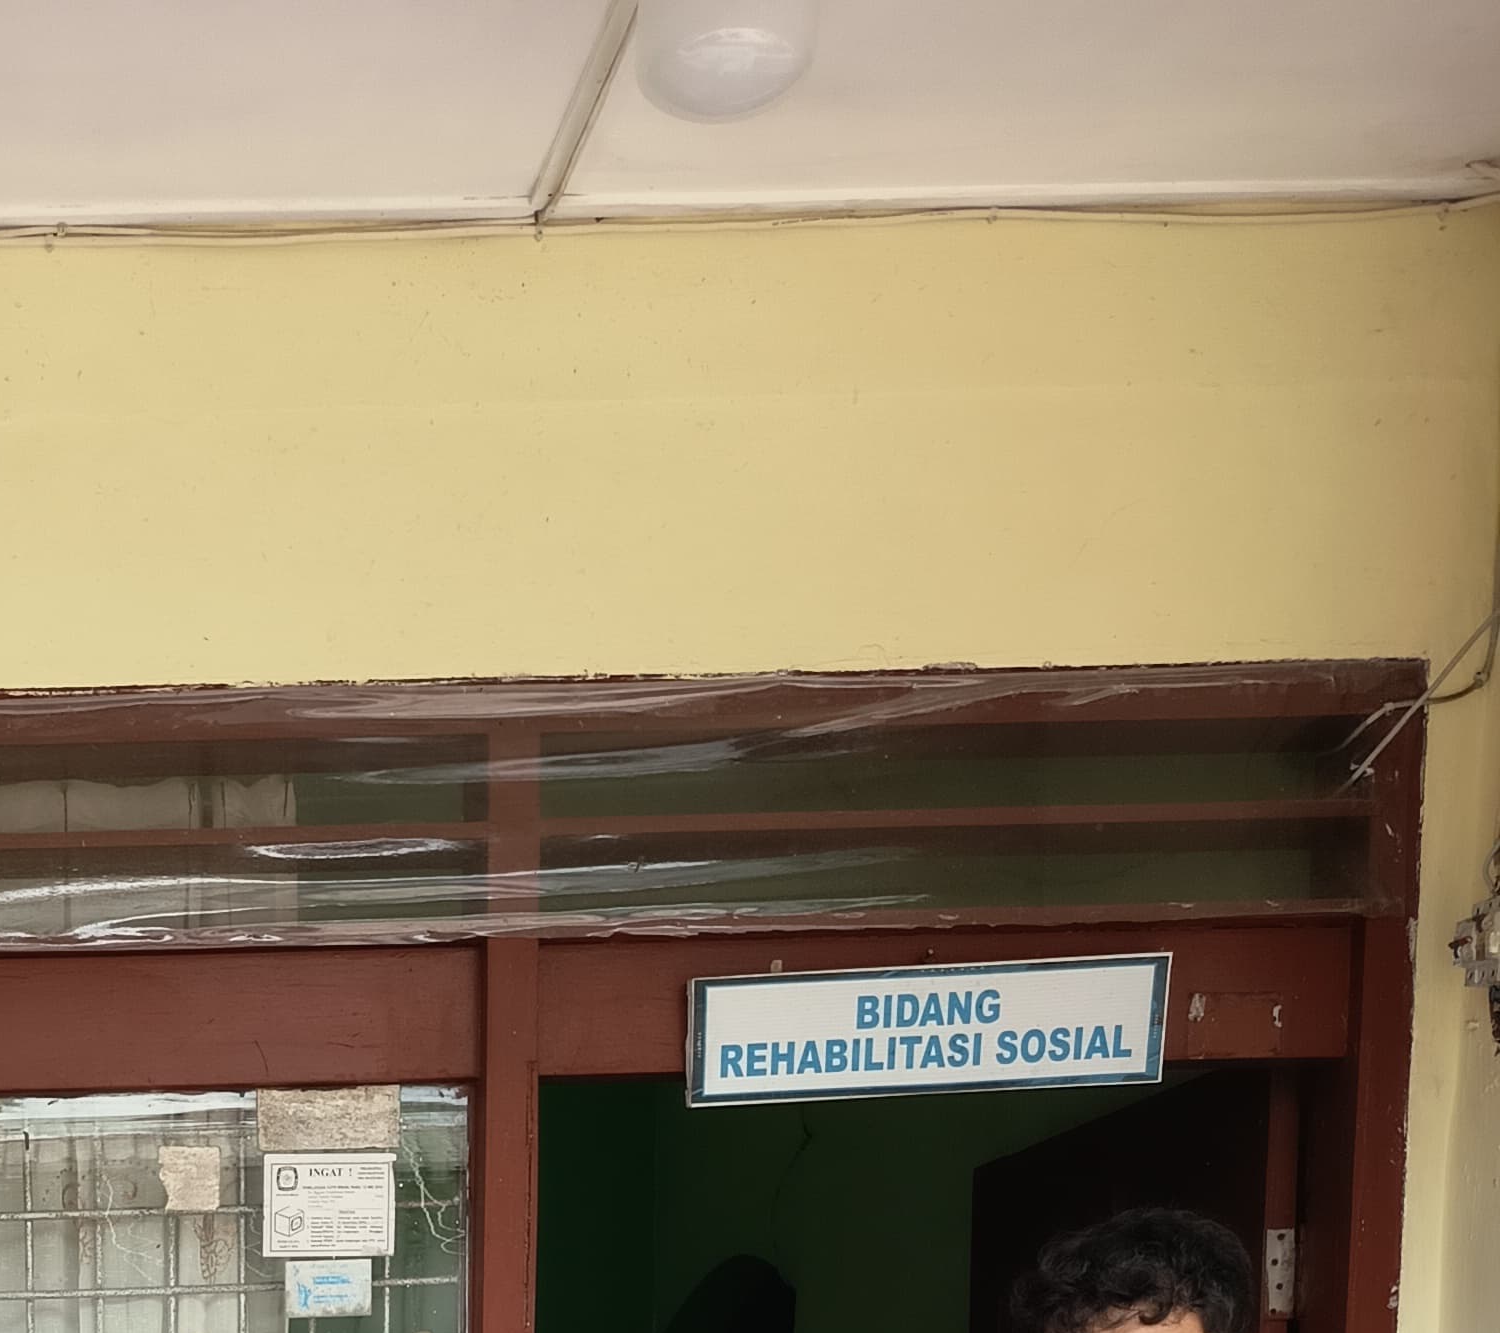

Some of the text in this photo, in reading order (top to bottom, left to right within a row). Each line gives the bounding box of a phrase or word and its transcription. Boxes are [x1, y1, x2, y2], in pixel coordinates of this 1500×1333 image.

[856, 989, 1001, 1029] BIDANG
[720, 1024, 1133, 1079] REHABILITASI SOSIAL
[309, 1167, 344, 1177] INGAT
